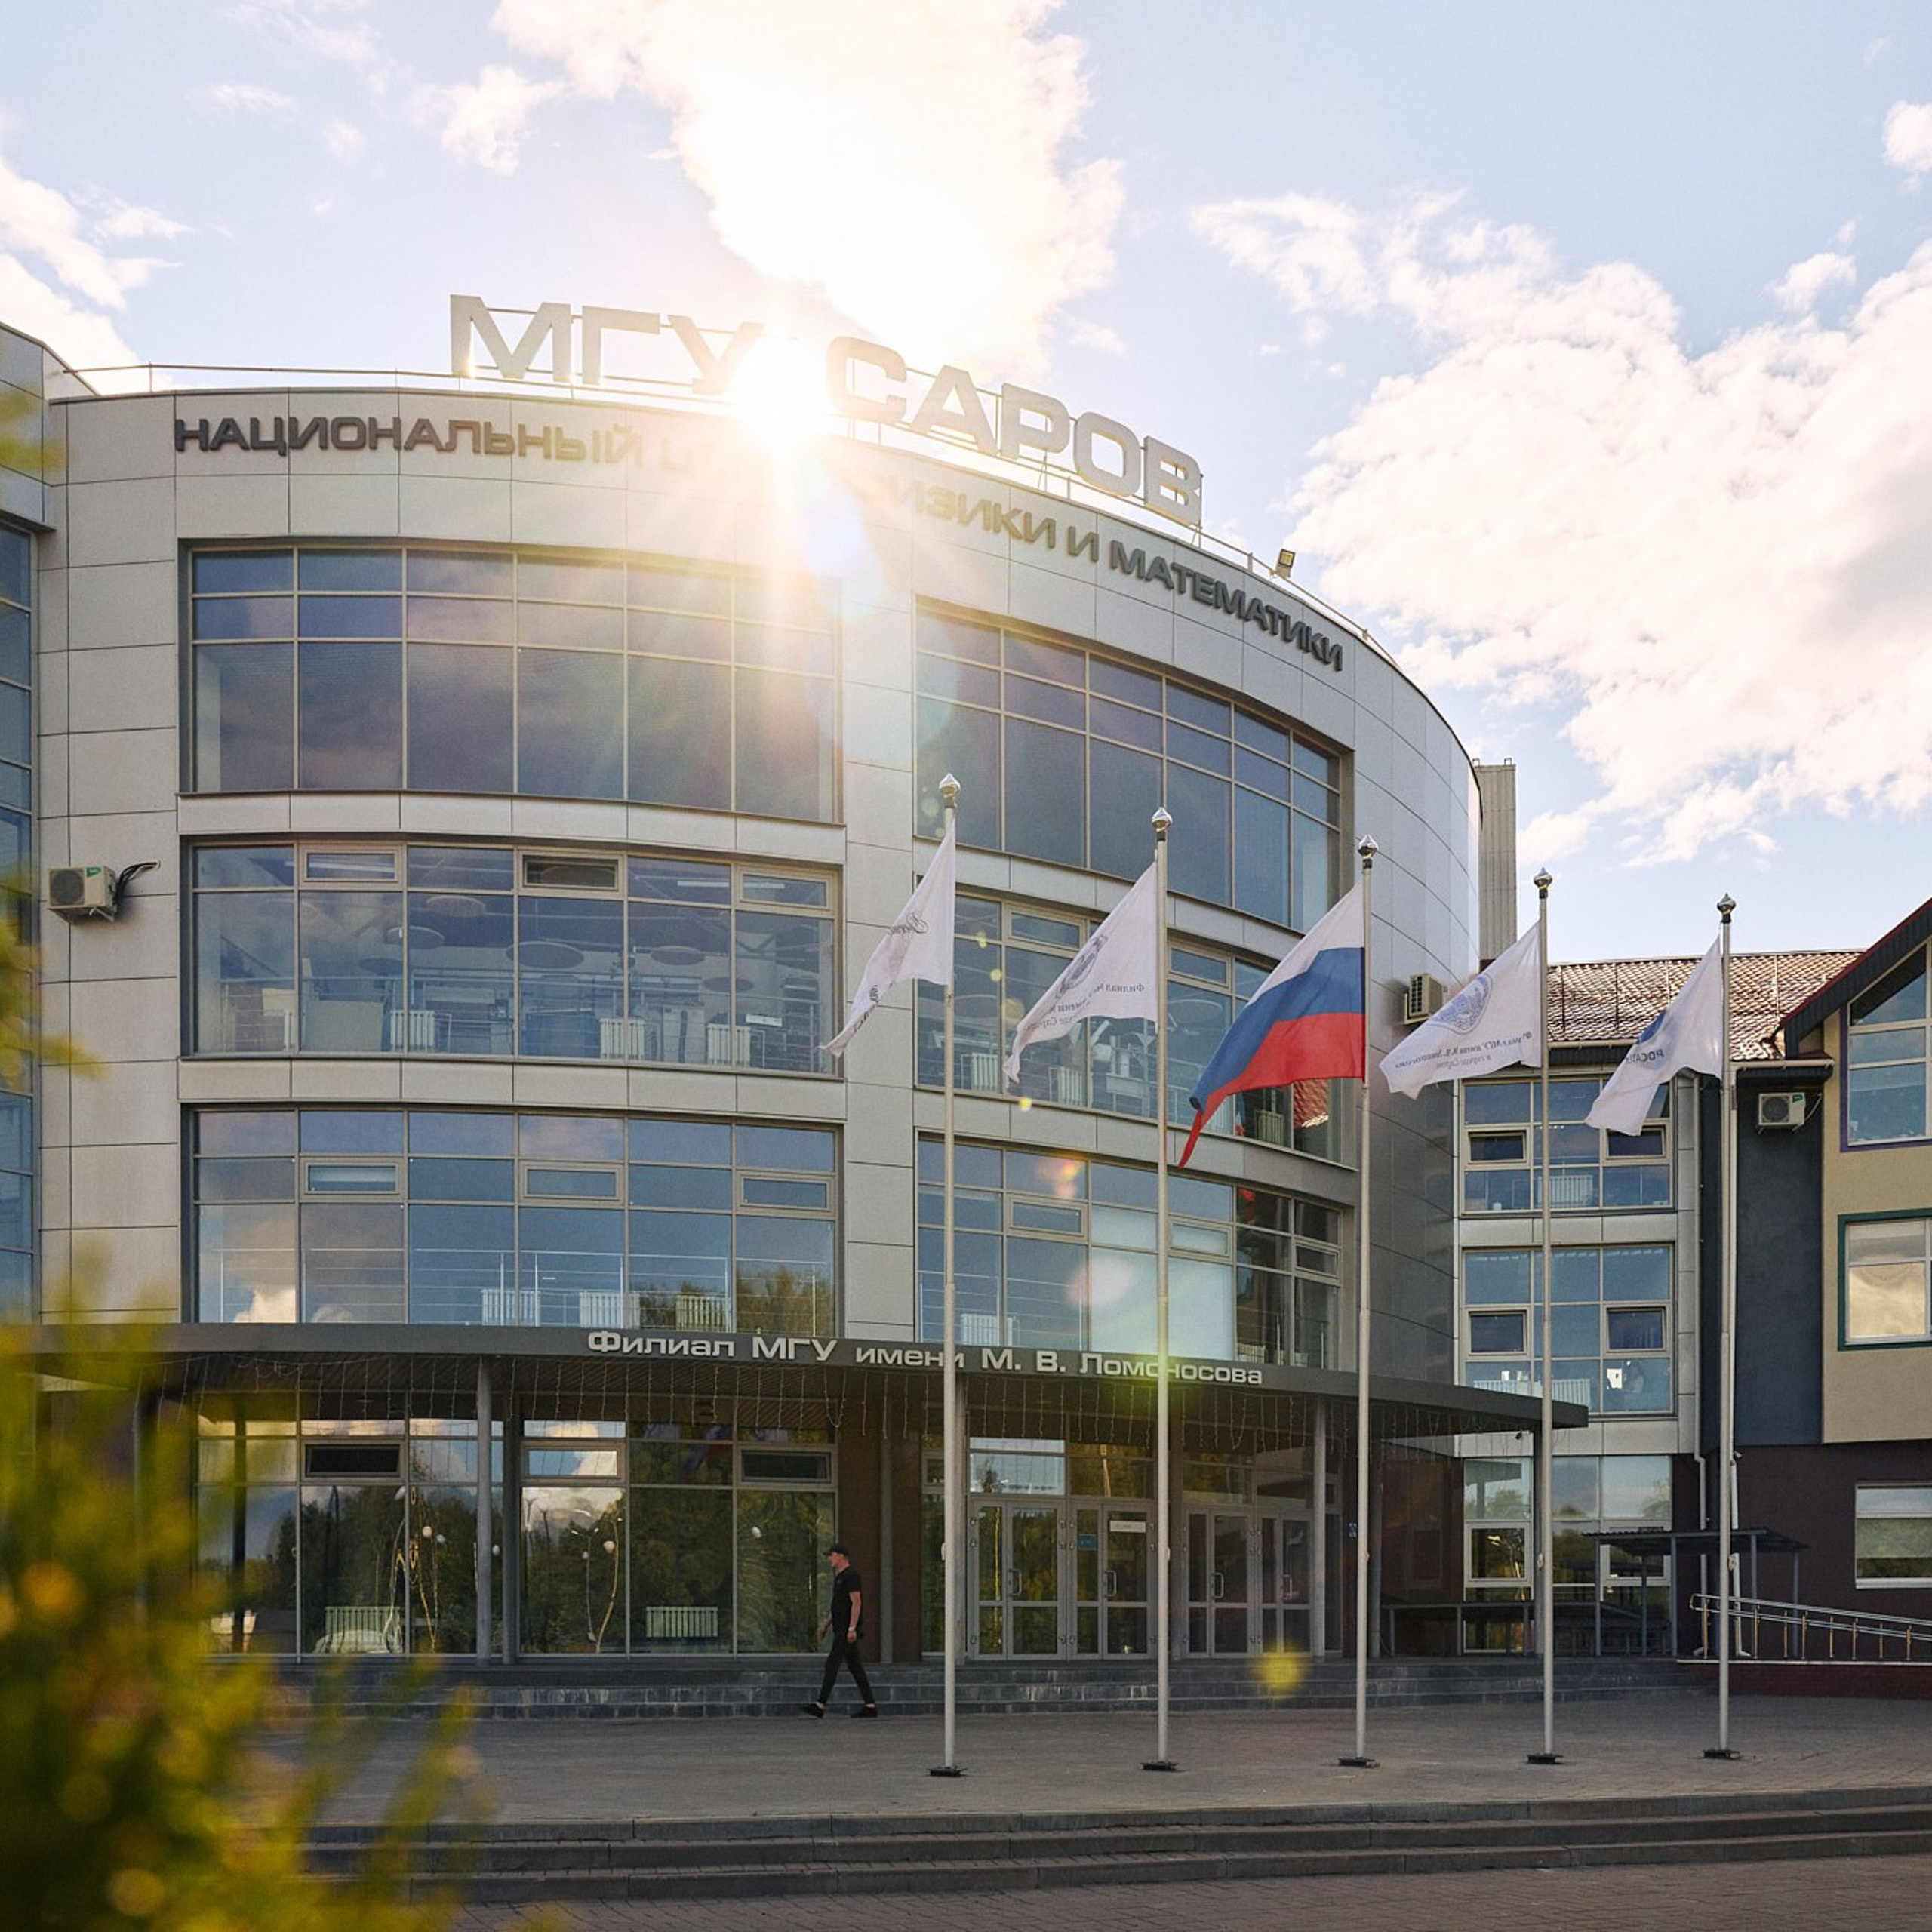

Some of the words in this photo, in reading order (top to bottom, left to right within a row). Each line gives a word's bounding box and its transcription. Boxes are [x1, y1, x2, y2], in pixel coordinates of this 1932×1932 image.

[450, 294, 764, 395] МГУ
[826, 336, 1203, 527] САРОВ
[174, 416, 644, 469] НАЦИОНАЛЬНЫЙ
[886, 472, 1056, 549] ИЗИКИ
[1066, 525, 1099, 562] И
[1109, 539, 1343, 672] МАТЕМАТИКИ
[588, 1330, 735, 1358] Филиал
[752, 1337, 837, 1361] МГУ
[855, 1346, 965, 1369] имени
[982, 1348, 1022, 1371] М.
[1035, 1350, 1066, 1373] В.
[1079, 1352, 1263, 1386] Ломоносова
